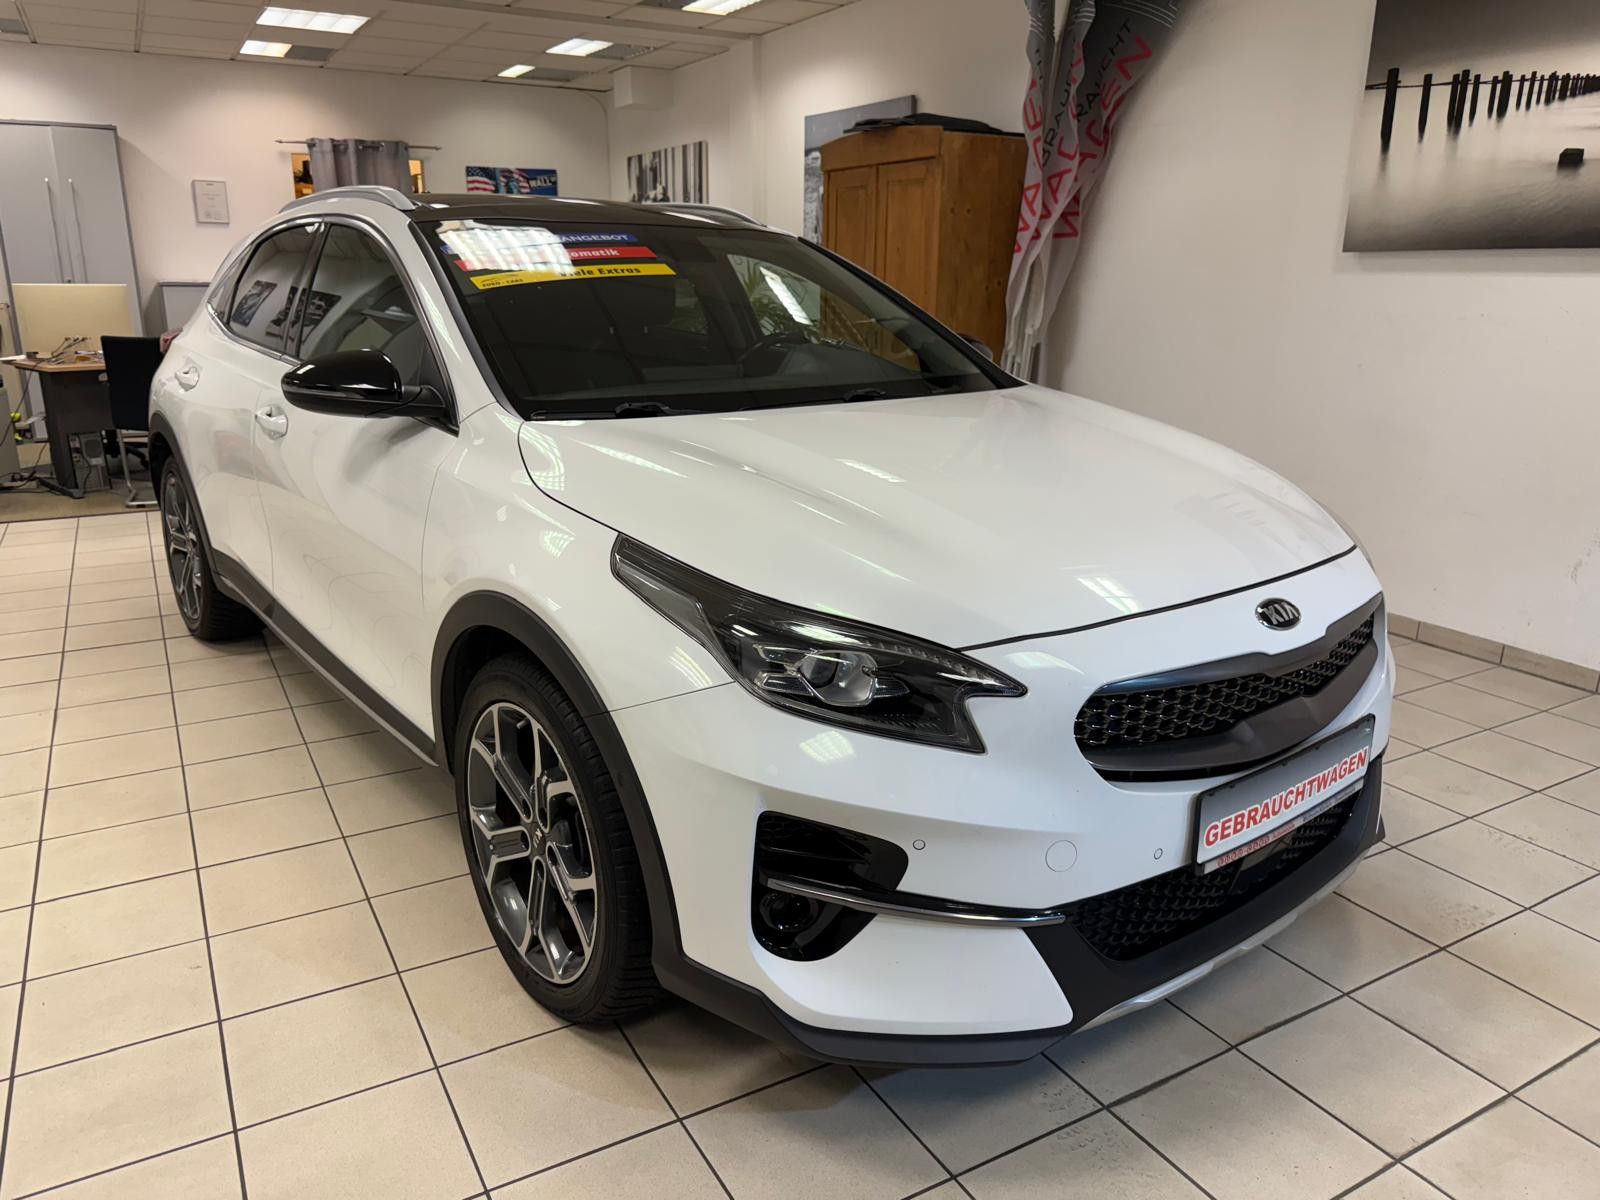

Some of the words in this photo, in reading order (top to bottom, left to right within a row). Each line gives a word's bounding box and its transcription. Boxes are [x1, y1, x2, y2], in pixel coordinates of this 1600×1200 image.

[561, 233, 629, 242] ANGEBOT
[567, 248, 620, 258] omatik
[597, 266, 642, 276] Extras
[1263, 601, 1299, 625] KIA
[1204, 747, 1369, 847] GEBRAUCHTWAGEN
